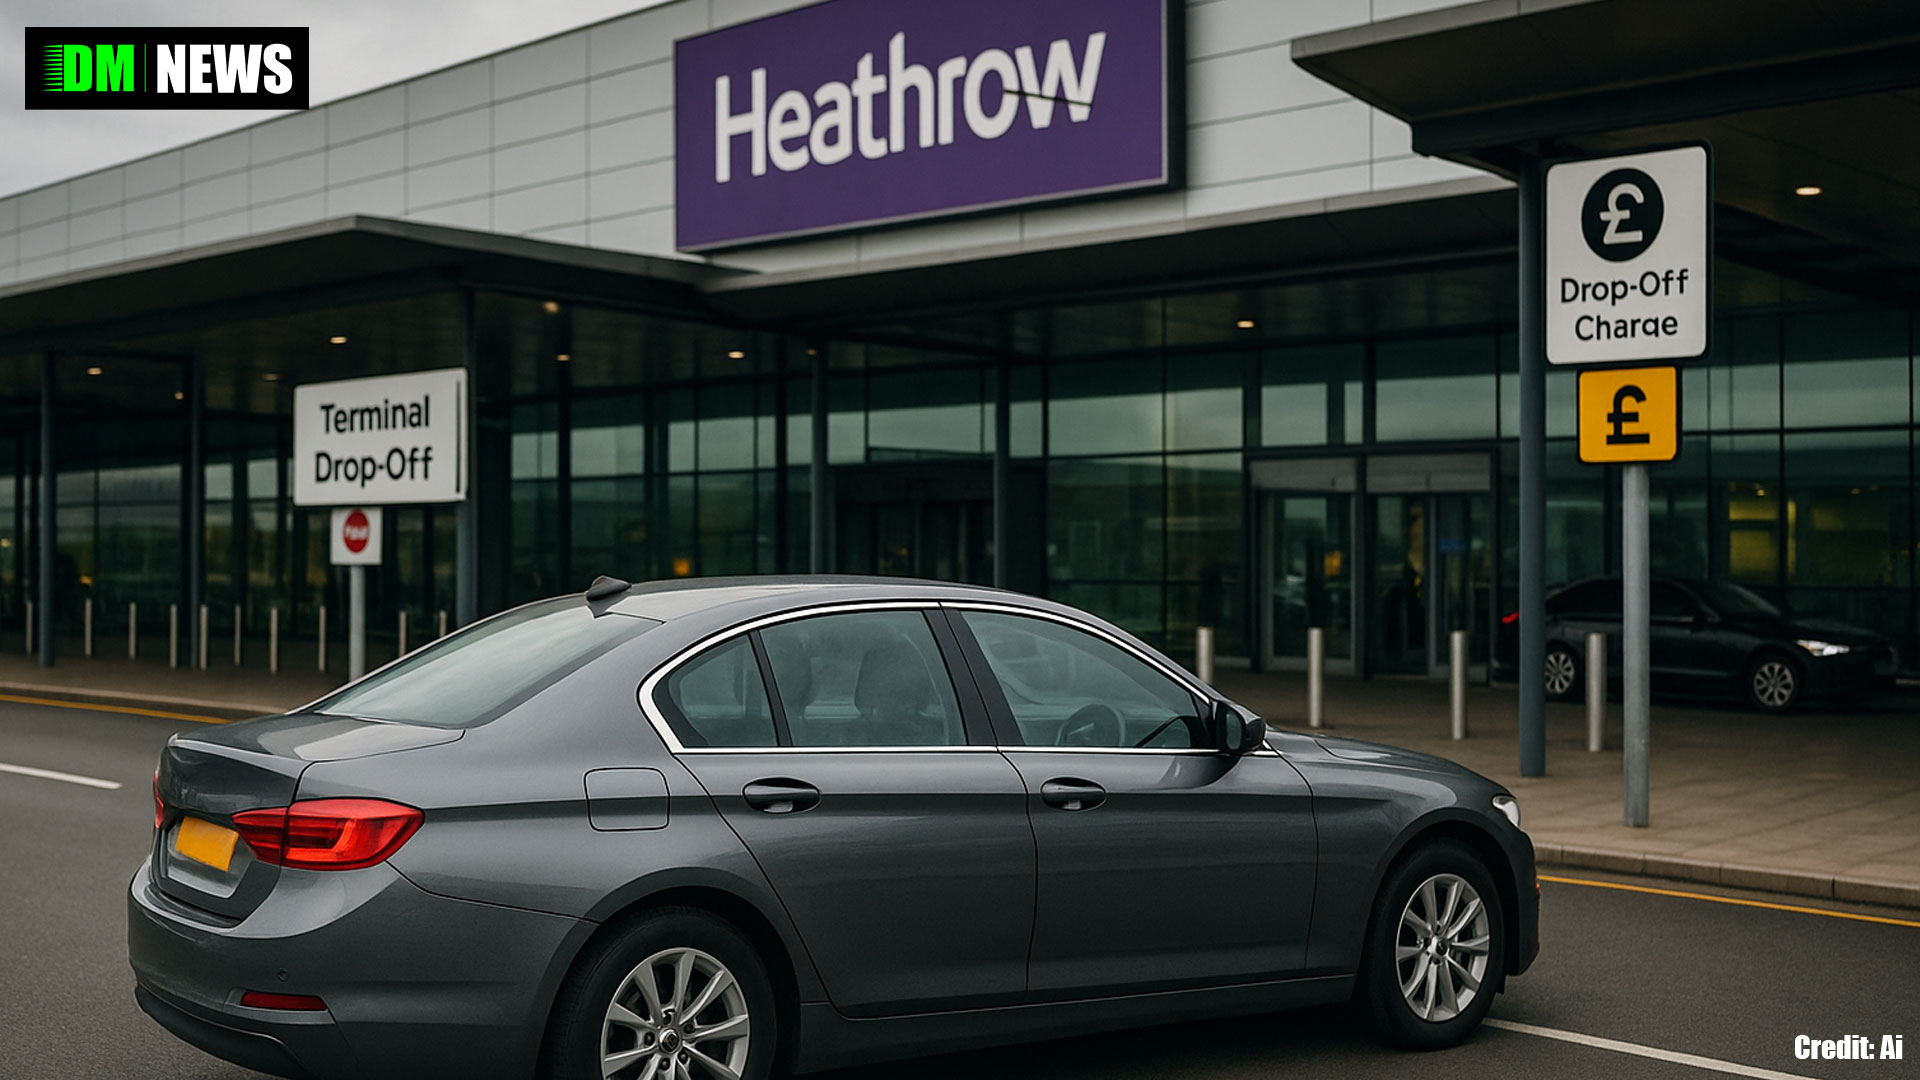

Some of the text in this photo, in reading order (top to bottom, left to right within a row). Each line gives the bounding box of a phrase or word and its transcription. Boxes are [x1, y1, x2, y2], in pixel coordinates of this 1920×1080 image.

[714, 31, 1107, 184] Heathrow
[1560, 267, 1690, 307] Drop-Off
[319, 394, 431, 435] Terminal
[315, 445, 434, 488] Drop-Off
